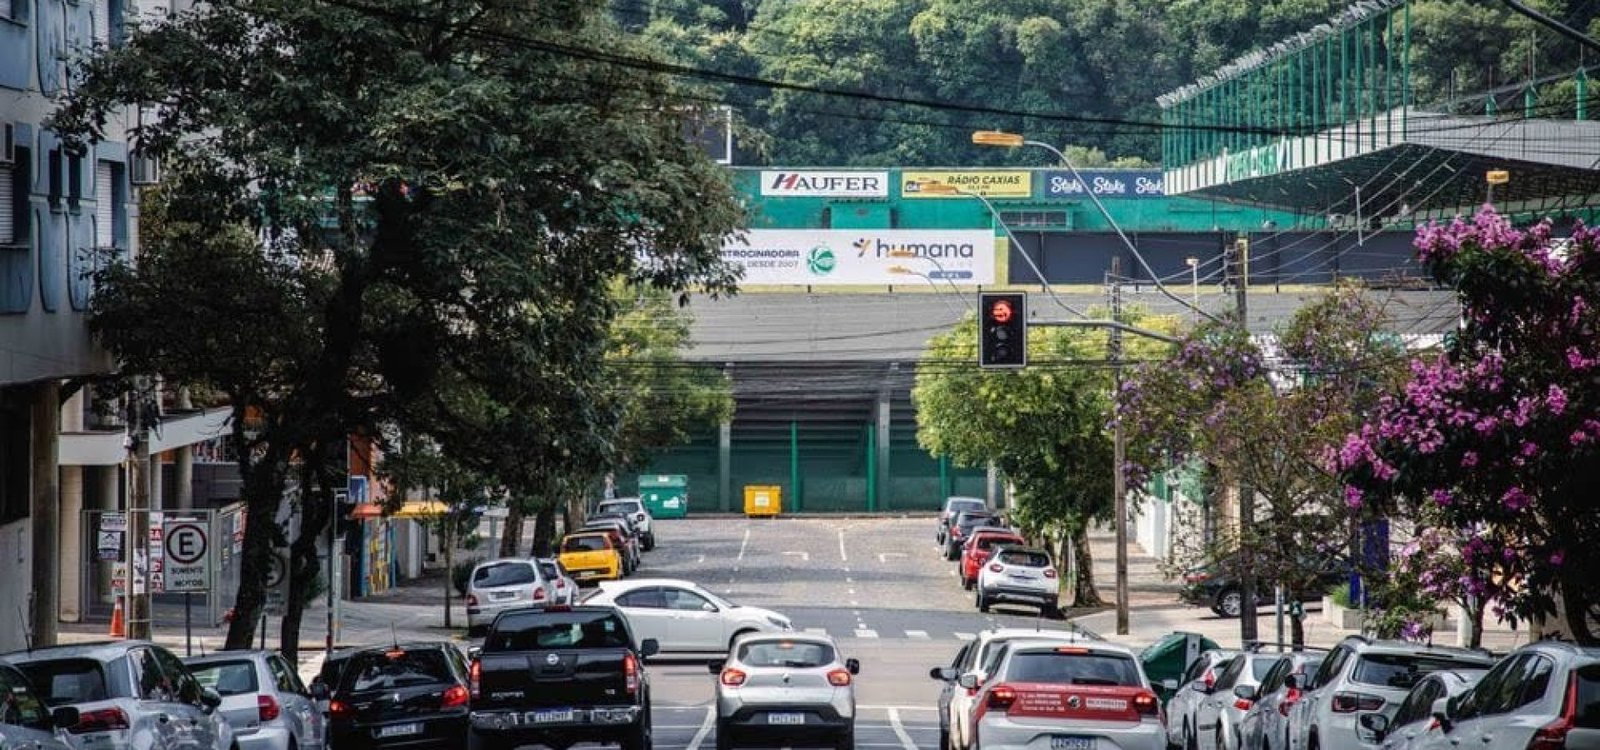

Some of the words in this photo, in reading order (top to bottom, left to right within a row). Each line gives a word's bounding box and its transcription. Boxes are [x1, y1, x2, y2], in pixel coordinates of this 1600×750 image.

[772, 174, 878, 190] HAUFER
[947, 174, 980, 184] RÁDIO
[982, 175, 1021, 184] CAXIAS
[717, 250, 799, 258] ATROCINADORA
[179, 532, 194, 555] E
